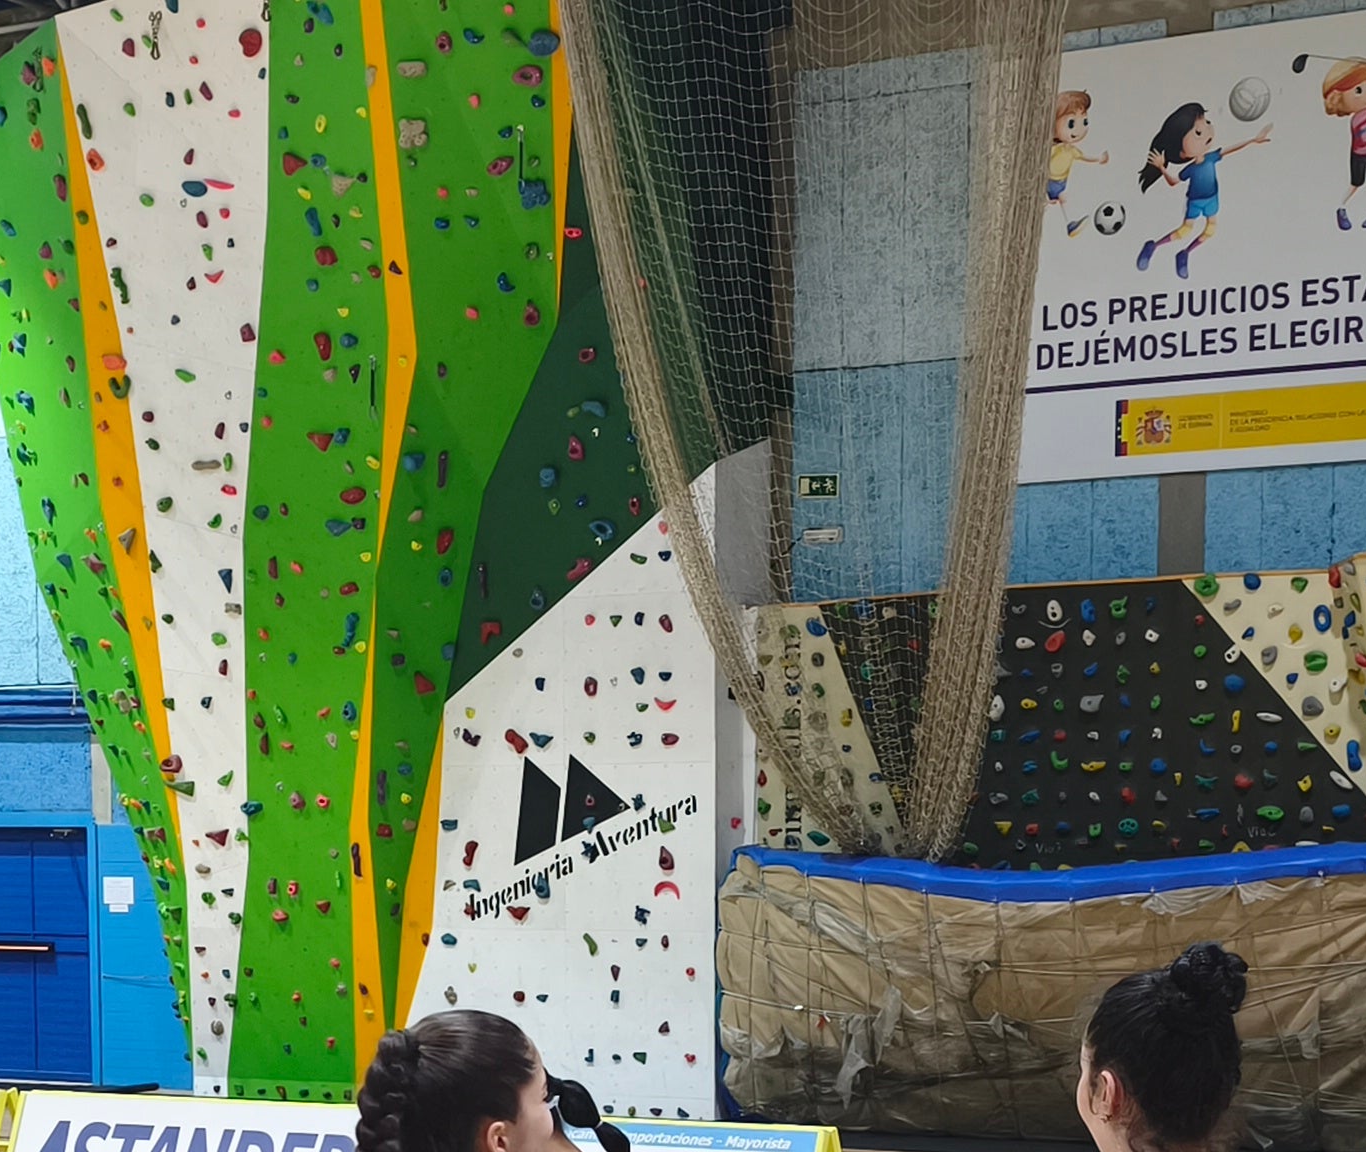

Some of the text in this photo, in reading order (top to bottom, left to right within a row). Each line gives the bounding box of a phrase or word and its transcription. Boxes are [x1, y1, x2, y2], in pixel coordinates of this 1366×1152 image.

[1041, 299, 1099, 331] LOS
[1107, 281, 1291, 325] PREJUICIOS
[1035, 326, 1238, 371] DEJÉMOSLES
[1247, 314, 1366, 352] ELEGIR
[724, 1134, 792, 1151] Mayorista
